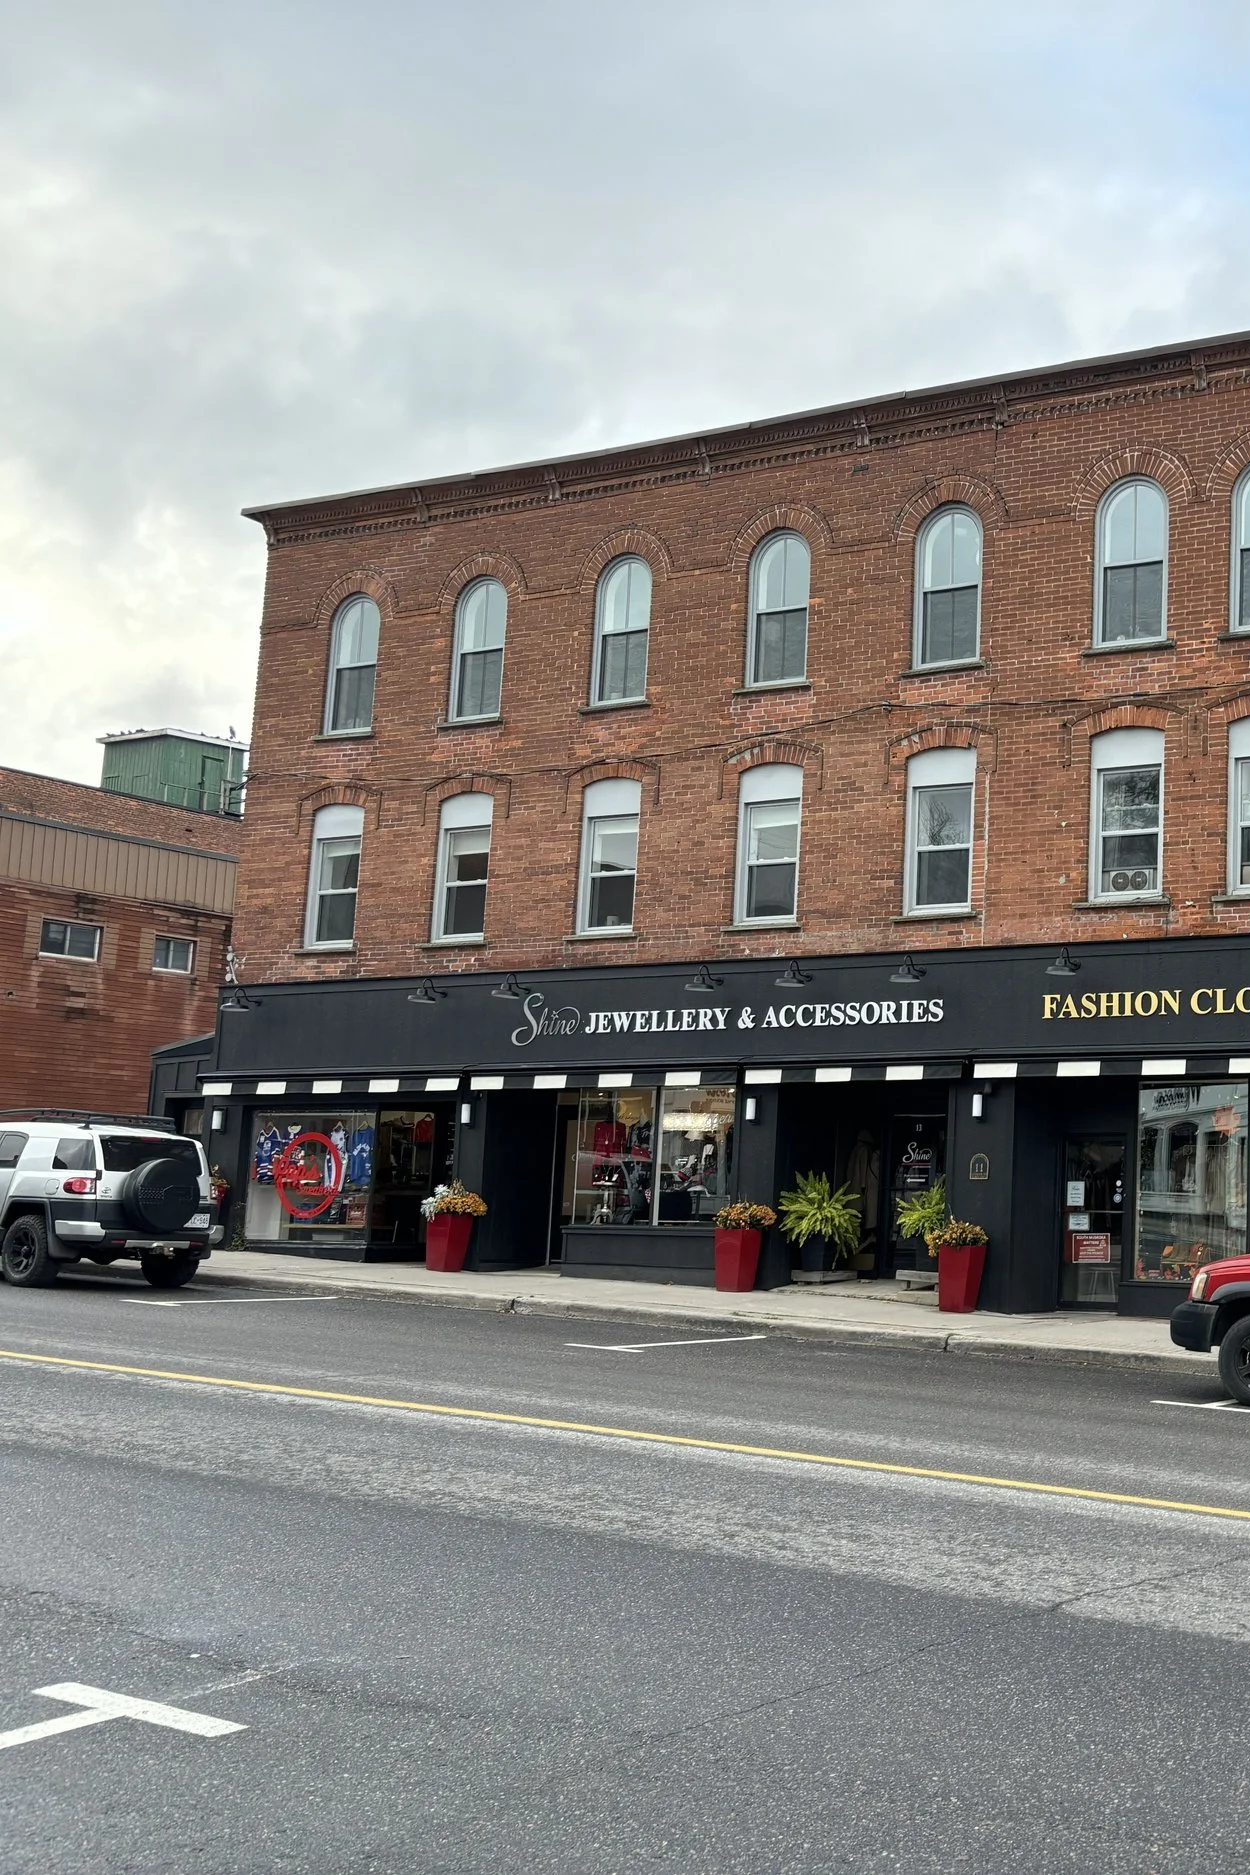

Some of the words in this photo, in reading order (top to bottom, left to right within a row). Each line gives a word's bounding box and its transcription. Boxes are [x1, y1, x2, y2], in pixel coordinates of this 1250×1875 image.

[1042, 990, 1182, 1019] FASHION
[511, 993, 581, 1046] Shine
[585, 1008, 731, 1034] JEWELLERY
[738, 1006, 756, 1029] &
[761, 999, 944, 1028] ACCESSORIES
[902, 1141, 932, 1163] Shine
